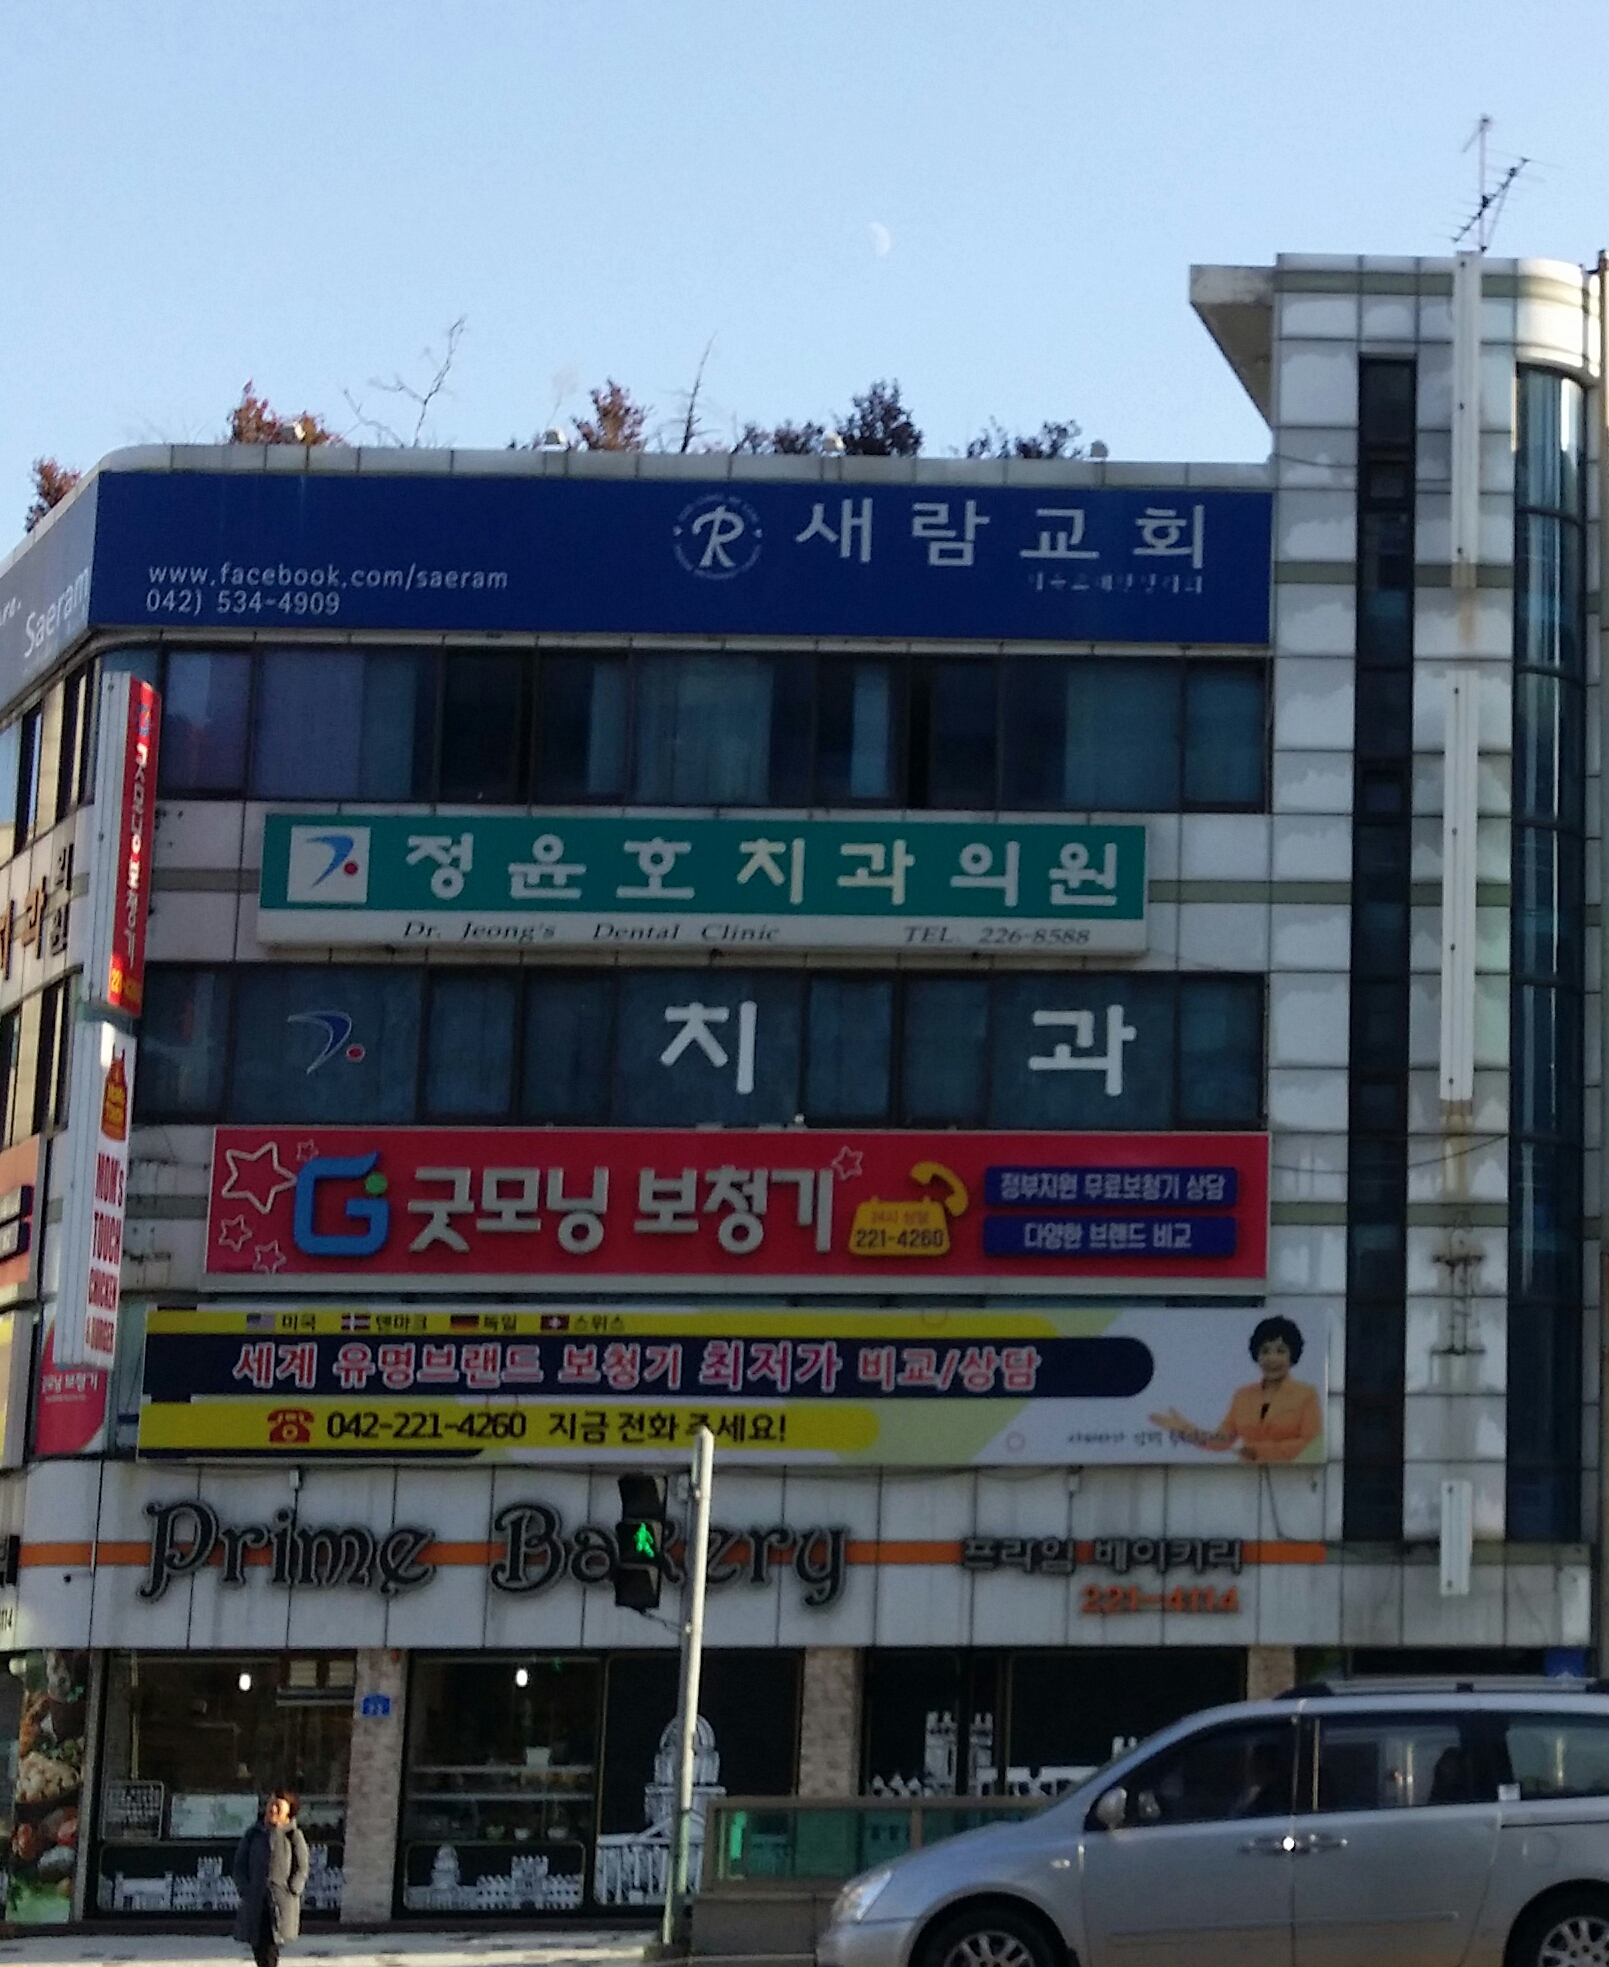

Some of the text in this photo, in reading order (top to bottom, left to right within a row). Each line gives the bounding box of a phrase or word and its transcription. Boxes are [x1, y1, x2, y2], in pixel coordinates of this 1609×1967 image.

[795, 497, 1205, 569] 새람교회
[149, 562, 508, 591] www.facebook.com/saeram
[146, 588, 341, 616] 042) 534-4909
[405, 832, 1118, 908] 정윤호치과의원
[403, 920, 441, 940] Dr.
[461, 920, 558, 945] Jeong's
[593, 922, 681, 942] Dental
[701, 923, 780, 943] Clinic
[978, 926, 1093, 946] 226-8588
[1001, 1172, 1226, 1201] 정부지원 무료보청기 상담
[407, 1164, 834, 1255] 굿모닝 보청기
[1023, 1222, 1084, 1251] 다양한
[1153, 1223, 1193, 1249] 비교
[280, 1314, 317, 1332] 미국
[574, 1315, 626, 1333] 스위스
[233, 1340, 1042, 1393] 세계 유명브랜드 보청기 최저가 비교/상담
[325, 1410, 527, 1440] 042-221-4260
[549, 1411, 608, 1443] 지금
[618, 1411, 680, 1443] 전화
[137, 1500, 436, 1601] Prime
[960, 1535, 1076, 1576] 프라임
[1080, 1583, 1240, 1614] 221-4114
